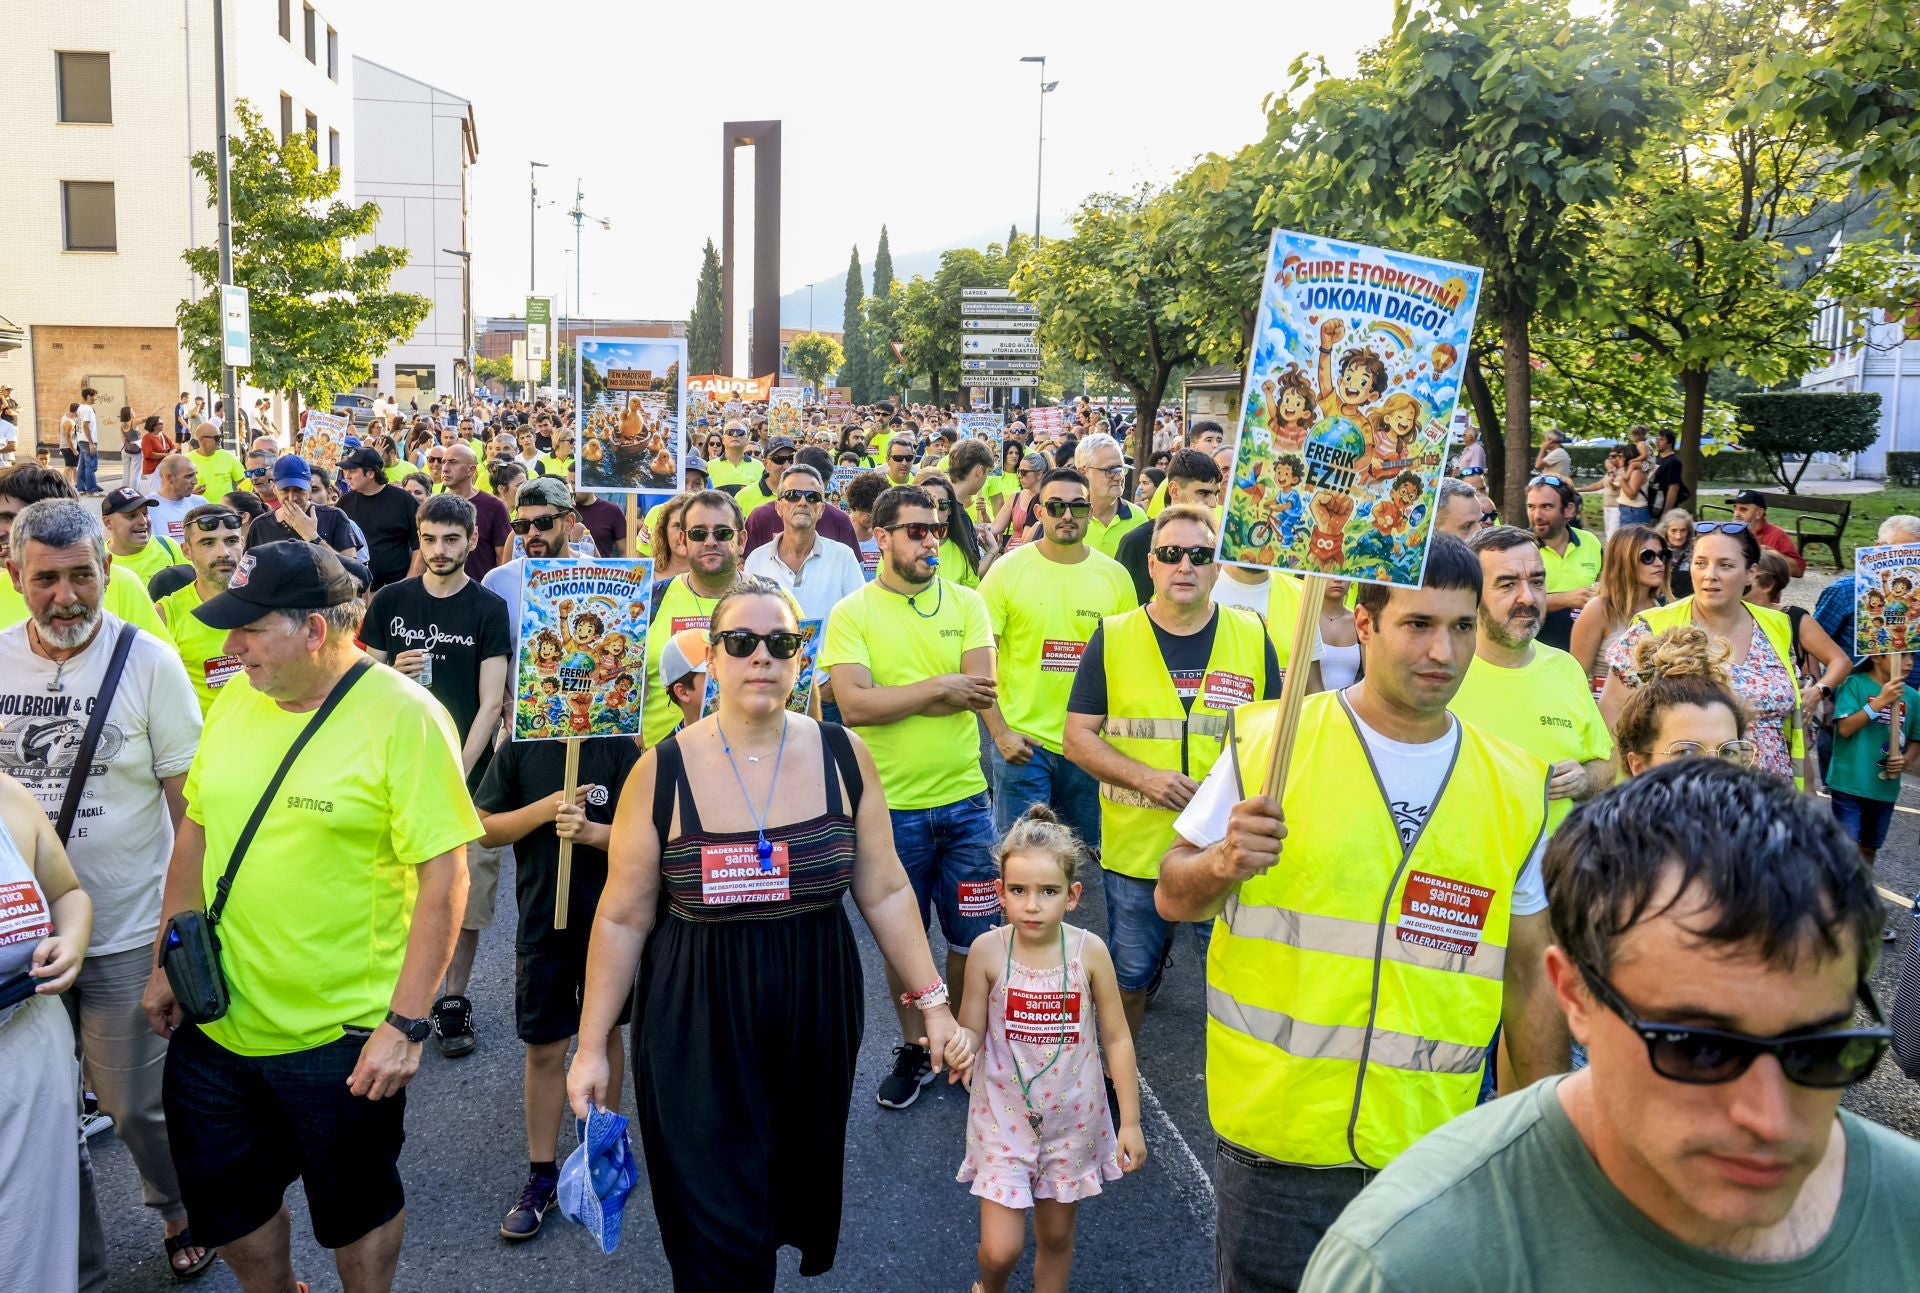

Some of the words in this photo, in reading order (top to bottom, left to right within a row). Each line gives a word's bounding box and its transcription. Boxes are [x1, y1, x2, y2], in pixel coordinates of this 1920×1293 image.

[1294, 260, 1345, 285] GURE
[1347, 262, 1461, 317] ETORKIZUNA
[1299, 287, 1382, 315] JOKOAN
[1383, 296, 1447, 337] DAGO!
[621, 372, 649, 380] MADERAS
[688, 379, 760, 395] GAUDE
[1305, 441, 1358, 469] ERERIK
[1305, 461, 1355, 496] EZ!!!
[1867, 551, 1887, 563] GURE
[1871, 557, 1905, 571] JOKOAN
[539, 567, 569, 586] GURE
[571, 567, 642, 587] ETORKIZUNA
[545, 581, 594, 598] JOKOAN
[596, 582, 636, 599] DAGO!
[390, 616, 426, 647] Pepe
[424, 624, 475, 650] Jeans
[210, 664, 246, 675] BORROKA
[560, 667, 592, 678] ERERIK
[561, 678, 592, 692] EZ!!!
[1220, 678, 1246, 688] garnica
[1210, 684, 1252, 700] BORROKAN
[73, 699, 82, 711] &
[1539, 715, 1573, 728] garnica
[287, 796, 333, 813] garnica
[77, 806, 106, 818] TACKLE.
[725, 854, 761, 865] garnic
[711, 866, 781, 879] BORROKAN
[1413, 875, 1451, 890] MADERAS
[1452, 883, 1463, 892] DE
[1463, 885, 1488, 898] LLODIO
[708, 893, 771, 905] KALERATZERIK
[771, 892, 785, 901] EZ!
[1429, 888, 1471, 907] garnica
[1411, 900, 1479, 926] BORROKAN
[1414, 921, 1445, 933] DESPIDOS,
[1401, 931, 1463, 953] KALERATZERIK
[1462, 944, 1473, 955] EZ!
[1012, 991, 1042, 1000] MADERAS
[1025, 1001, 1061, 1010] garnica
[1013, 1010, 1072, 1021] BORROKAN
